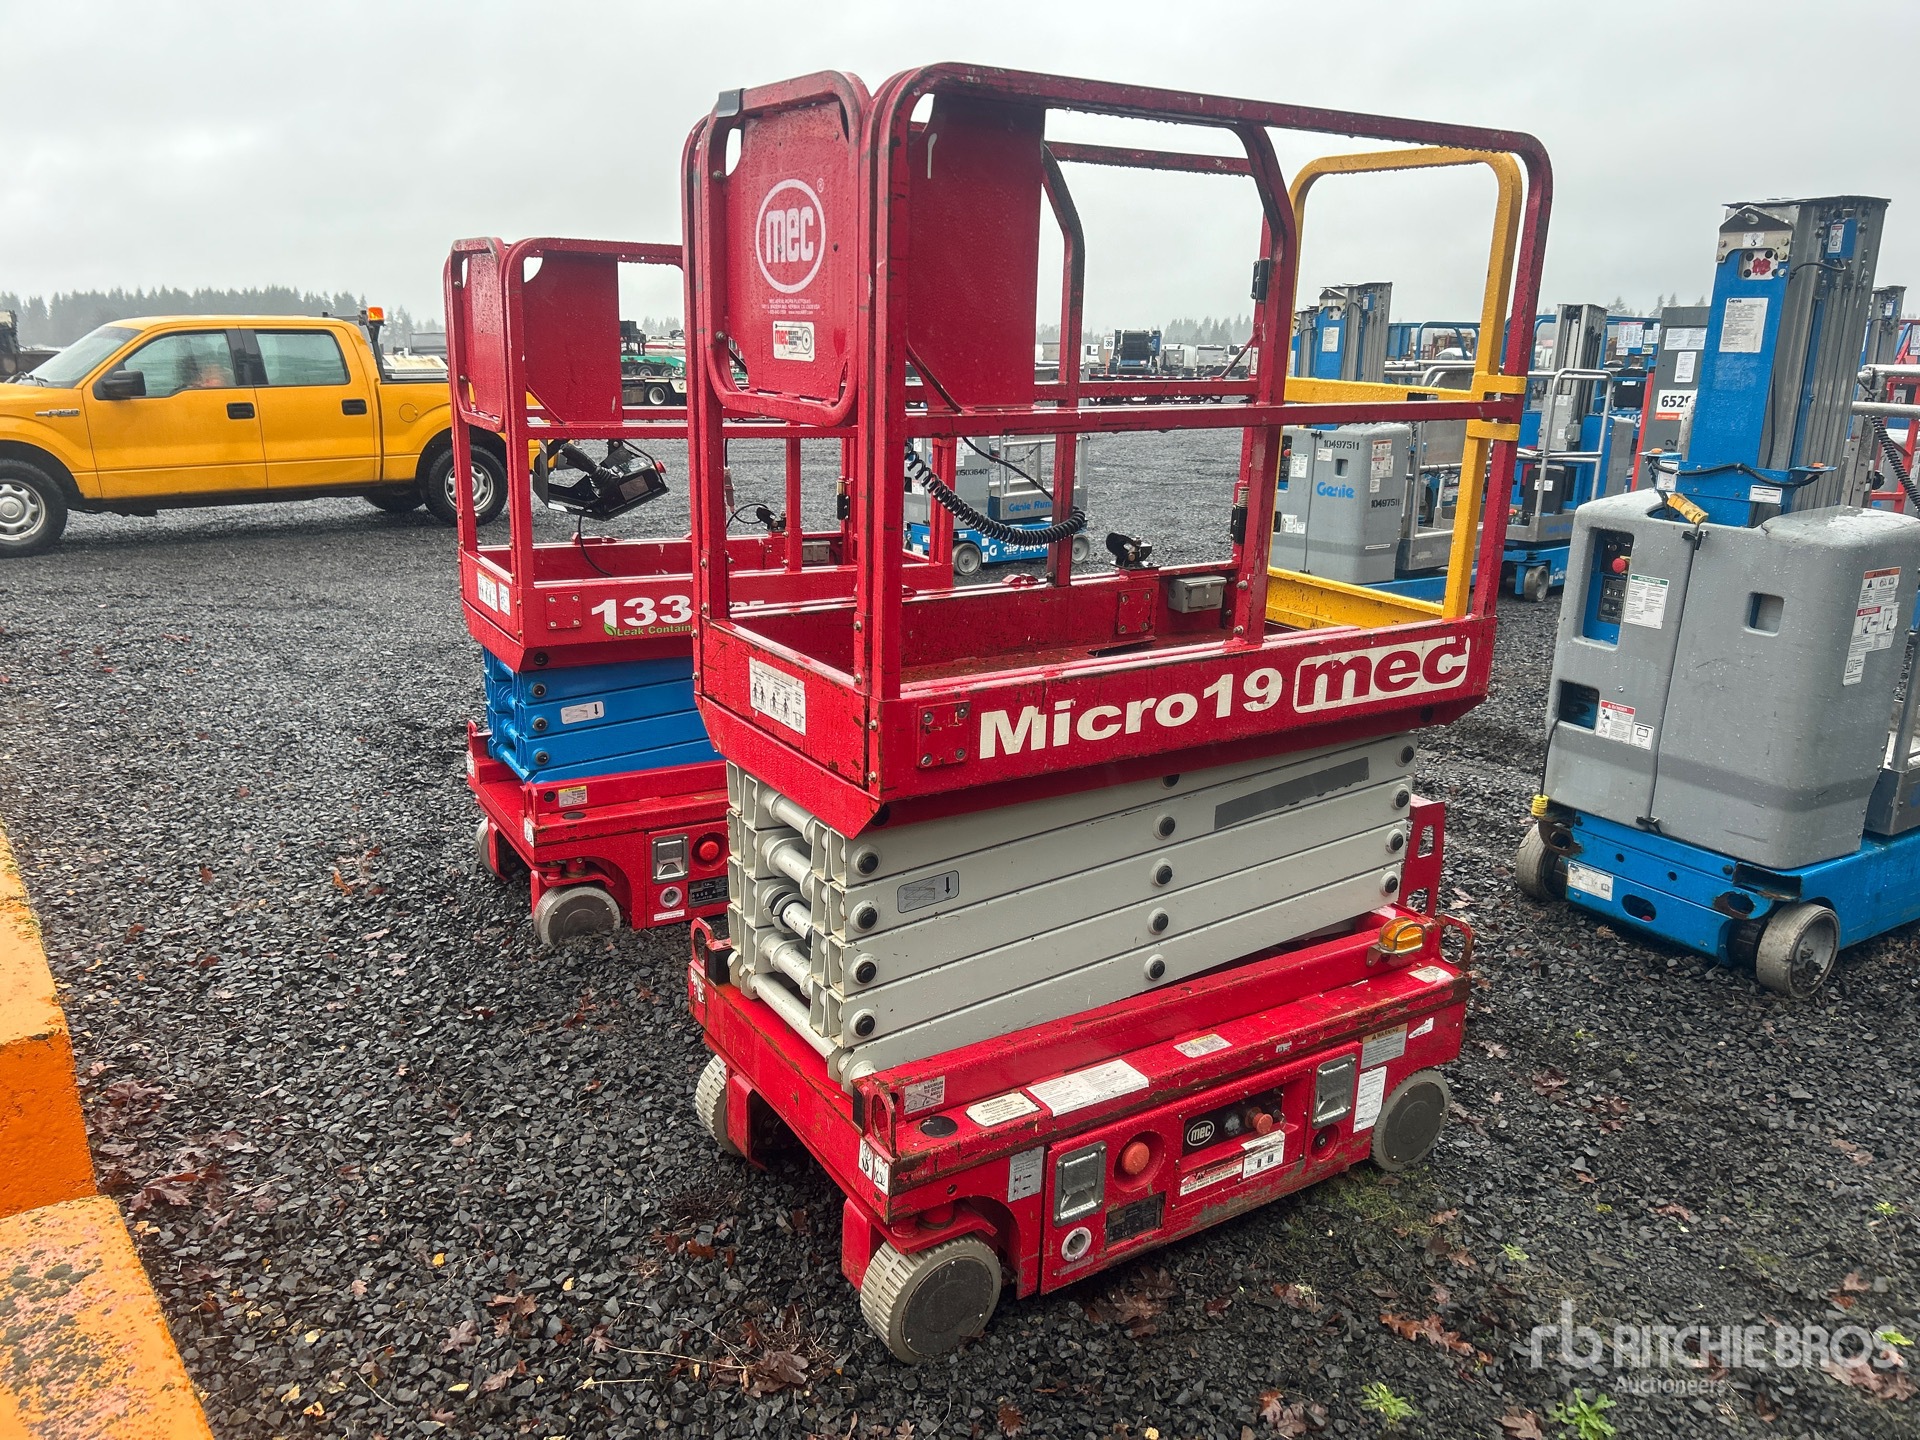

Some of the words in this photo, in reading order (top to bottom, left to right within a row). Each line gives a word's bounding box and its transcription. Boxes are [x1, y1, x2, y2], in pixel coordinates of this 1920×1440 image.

[766, 206, 814, 263] mec
[775, 330, 789, 345] mec
[1324, 439, 1360, 451] 10497511
[1316, 481, 1355, 499] Genie
[1008, 501, 1031, 512] Genie
[617, 628, 645, 637] Leak
[648, 624, 693, 634] Contain
[1300, 639, 1470, 708] mec
[1190, 1125, 1212, 1142] mec
